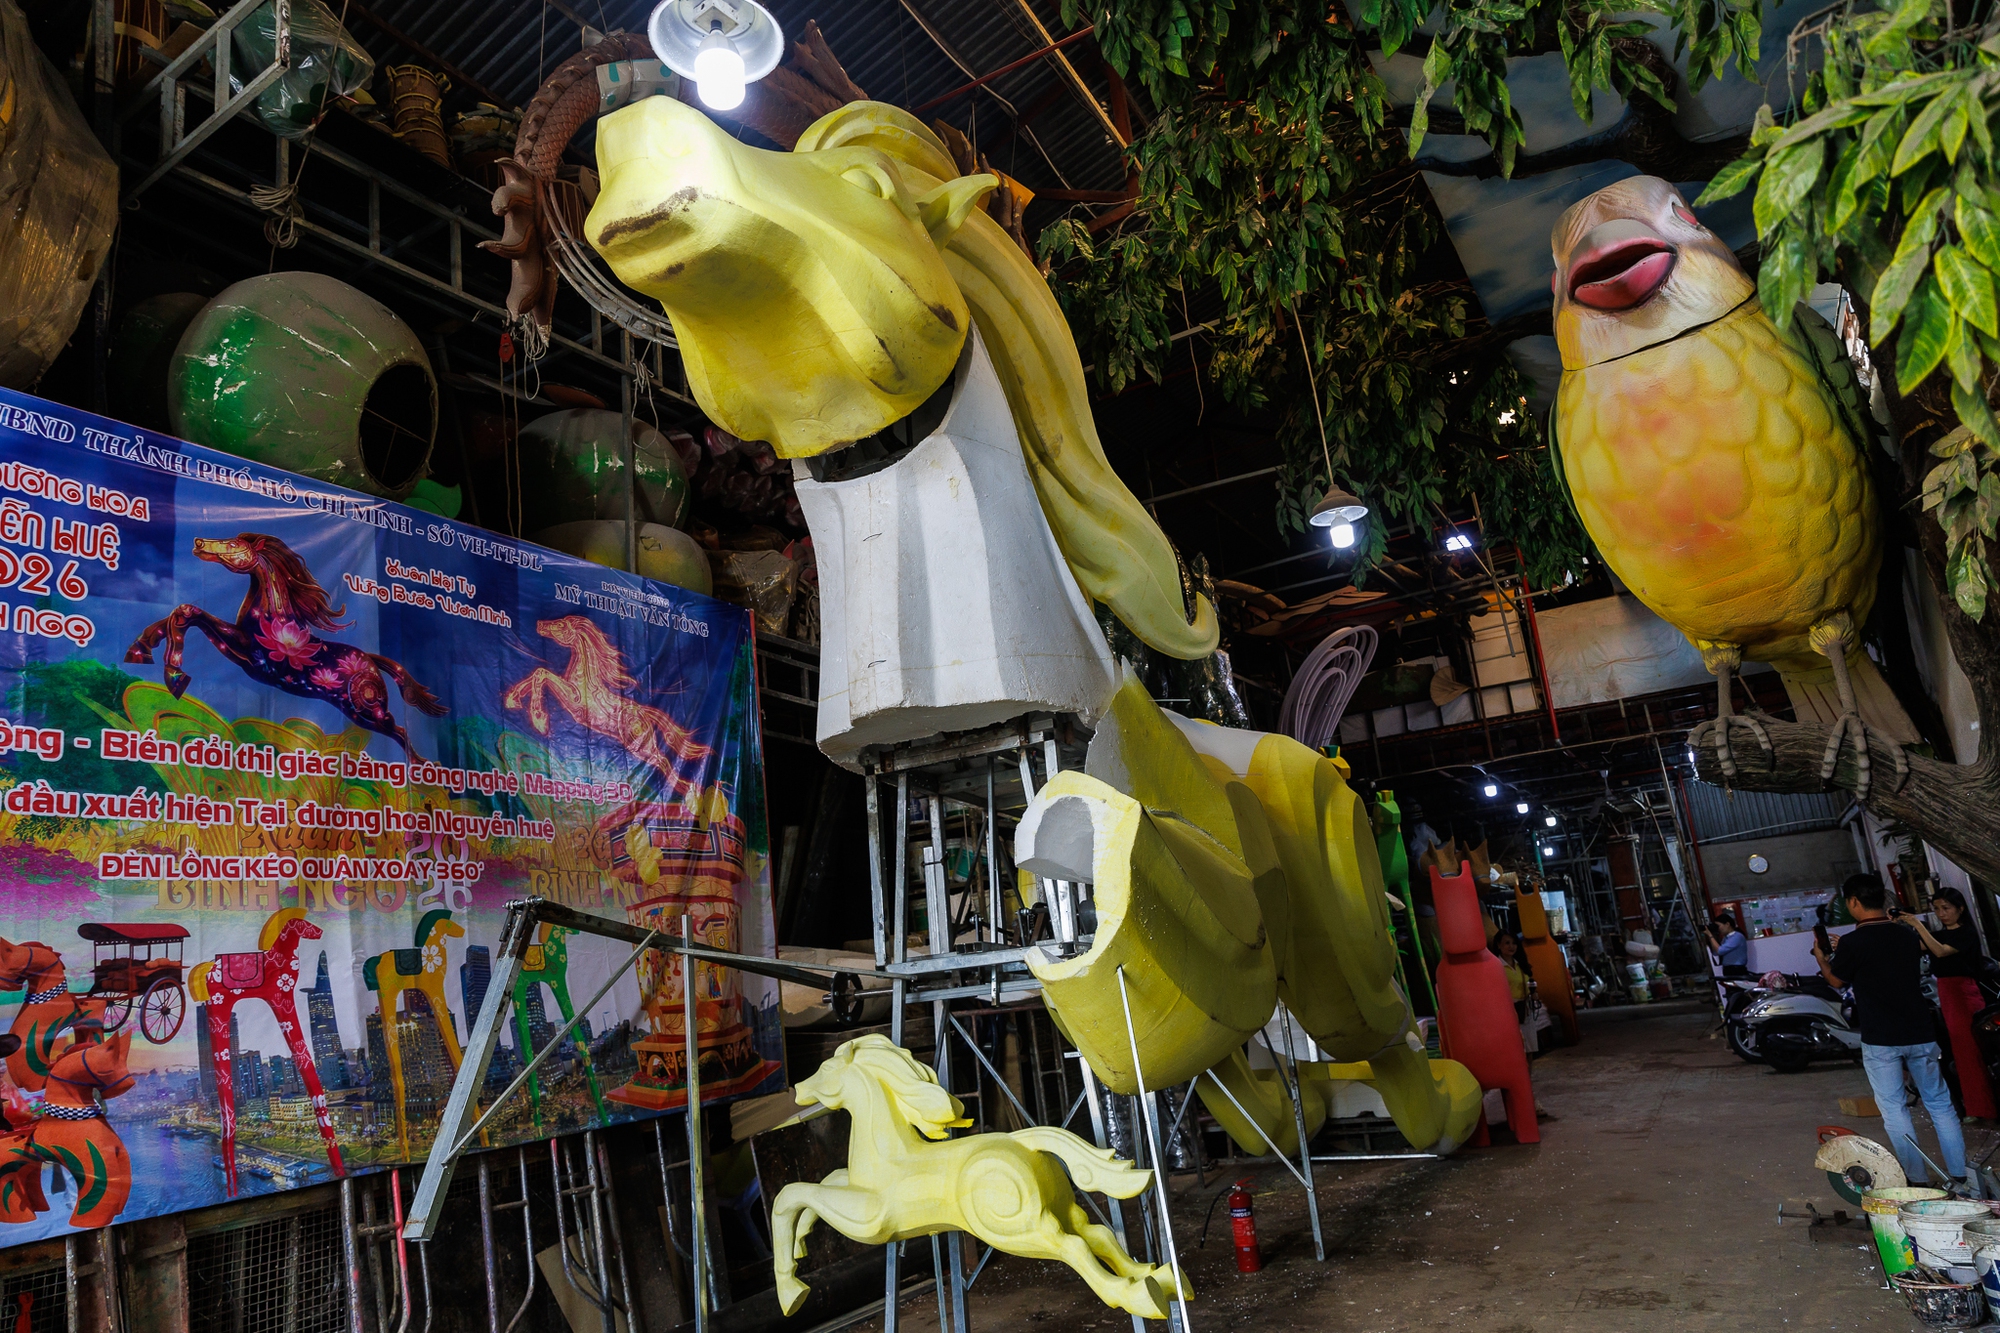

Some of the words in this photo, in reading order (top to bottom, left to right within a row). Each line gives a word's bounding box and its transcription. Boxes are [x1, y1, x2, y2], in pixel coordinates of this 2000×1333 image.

[0, 403, 76, 443] BND
[82, 427, 192, 476] THÀNH
[196, 459, 254, 491] PHỐ
[258, 476, 298, 503] HỒ
[303, 490, 347, 518] CHÍ
[351, 502, 412, 536] MINH
[427, 523, 454, 548] SỞ
[457, 533, 543, 572] VH-TT-DL
[0, 461, 84, 505] ƯỜNG
[87, 483, 150, 521] HOA
[51, 517, 120, 571] HUỆ
[343, 572, 390, 604] Vững
[392, 583, 435, 609] Bước
[437, 594, 477, 620] Vươn
[386, 557, 429, 585] Xuân
[430, 569, 455, 592] Hội
[456, 577, 476, 599] Tụ
[13, 605, 95, 647] NGỌ
[555, 582, 582, 605] MỸ
[584, 590, 637, 619] THUẬT
[639, 605, 669, 627] VĂN
[74, 737, 91, 748] -
[101, 729, 180, 765] Biến
[182, 734, 234, 770] đổi
[235, 742, 275, 779] thị
[277, 747, 338, 781] giác
[341, 752, 402, 788] bằng
[408, 759, 464, 794] công
[466, 767, 519, 797] nghệ
[524, 773, 603, 805] Mapping
[605, 781, 634, 802] 3D
[5, 779, 80, 817] đầu
[81, 786, 162, 821] xuất
[164, 793, 234, 827] hiện
[236, 798, 288, 831] Tại
[296, 801, 383, 837] đường
[383, 805, 433, 834] hoa
[434, 809, 516, 842] Nguyễn
[518, 814, 556, 843] huệ
[99, 852, 164, 881] ĐÈN
[165, 848, 243, 881] LỒNG
[244, 852, 300, 881] KÉO
[301, 856, 370, 881] QUÂN
[371, 858, 432, 882] XOAY
